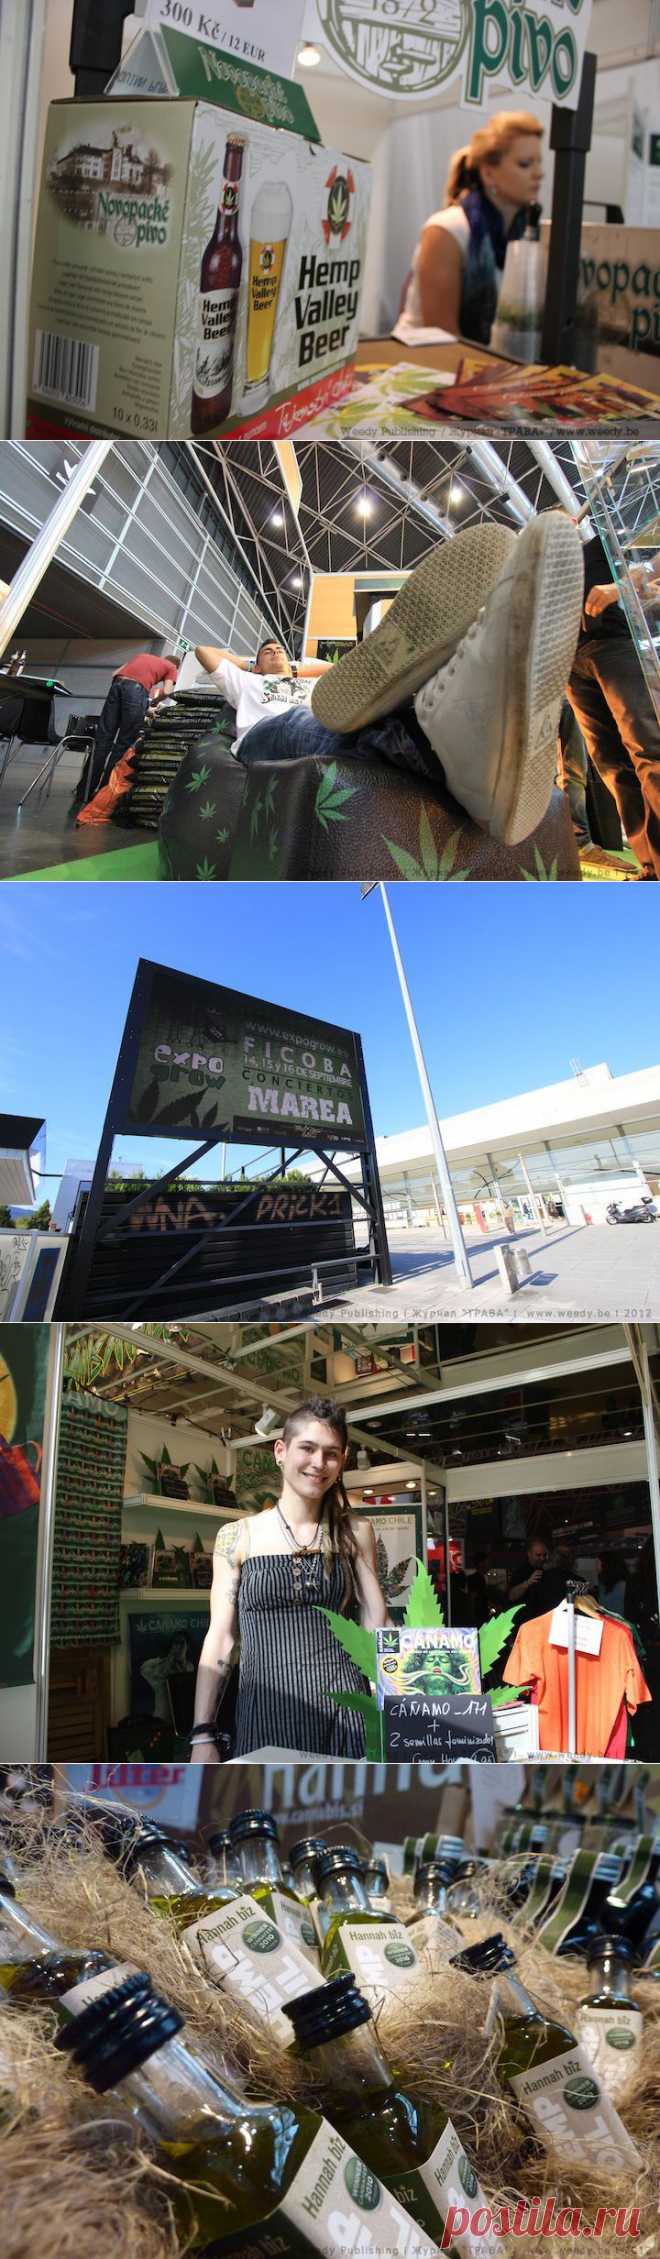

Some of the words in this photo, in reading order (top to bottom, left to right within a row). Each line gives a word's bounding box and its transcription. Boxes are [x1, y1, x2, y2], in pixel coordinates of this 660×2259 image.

[160, 0, 193, 25] 300
[198, 13, 220, 38] Kč
[229, 36, 241, 51] 12
[243, 42, 266, 63] EUR
[463, 0, 578, 105] pivo
[98, 192, 169, 225] Novopacké
[135, 223, 167, 248] pivo
[252, 274, 277, 290] Hemp
[298, 254, 360, 290] Hemp
[202, 299, 233, 314] Hem
[251, 286, 277, 300] Valley
[253, 299, 273, 312] Beer
[202, 311, 232, 327] Valle
[295, 289, 359, 331] Valley
[299, 324, 350, 369] Beer
[113, 406, 124, 421] 10
[154, 1044, 224, 1074] expo
[243, 1036, 352, 1078] FICOBA
[248, 1085, 353, 1126] MAREA
[389, 1731, 401, 1748] 2
[349, 1929, 388, 1941] Hannah
[522, 2067, 564, 2096] Hannah
[301, 2157, 338, 2220] Hannah
